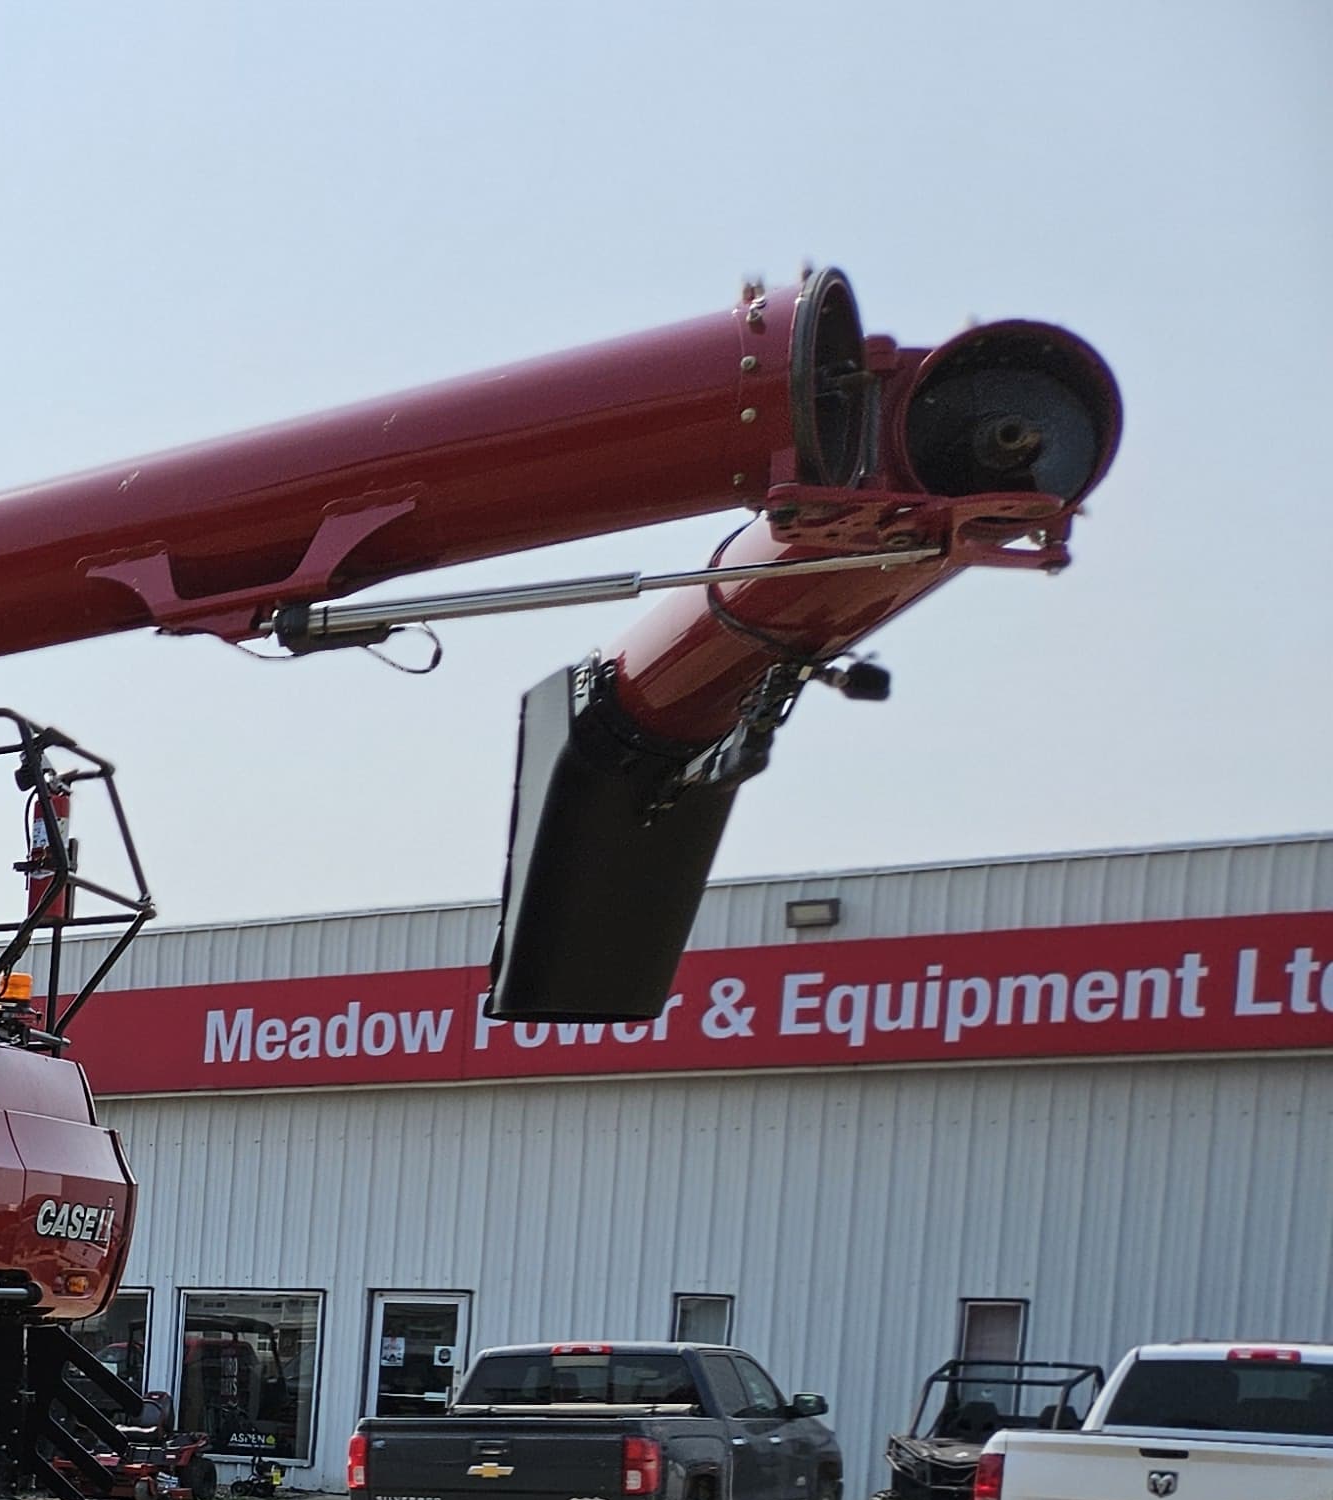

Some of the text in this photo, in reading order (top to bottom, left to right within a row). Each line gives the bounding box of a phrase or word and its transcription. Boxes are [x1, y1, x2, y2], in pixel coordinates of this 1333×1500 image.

[204, 1001, 454, 1064] Meadow
[701, 976, 755, 1039] &
[779, 953, 1208, 1047] Equipment
[37, 1200, 99, 1240] CASE
